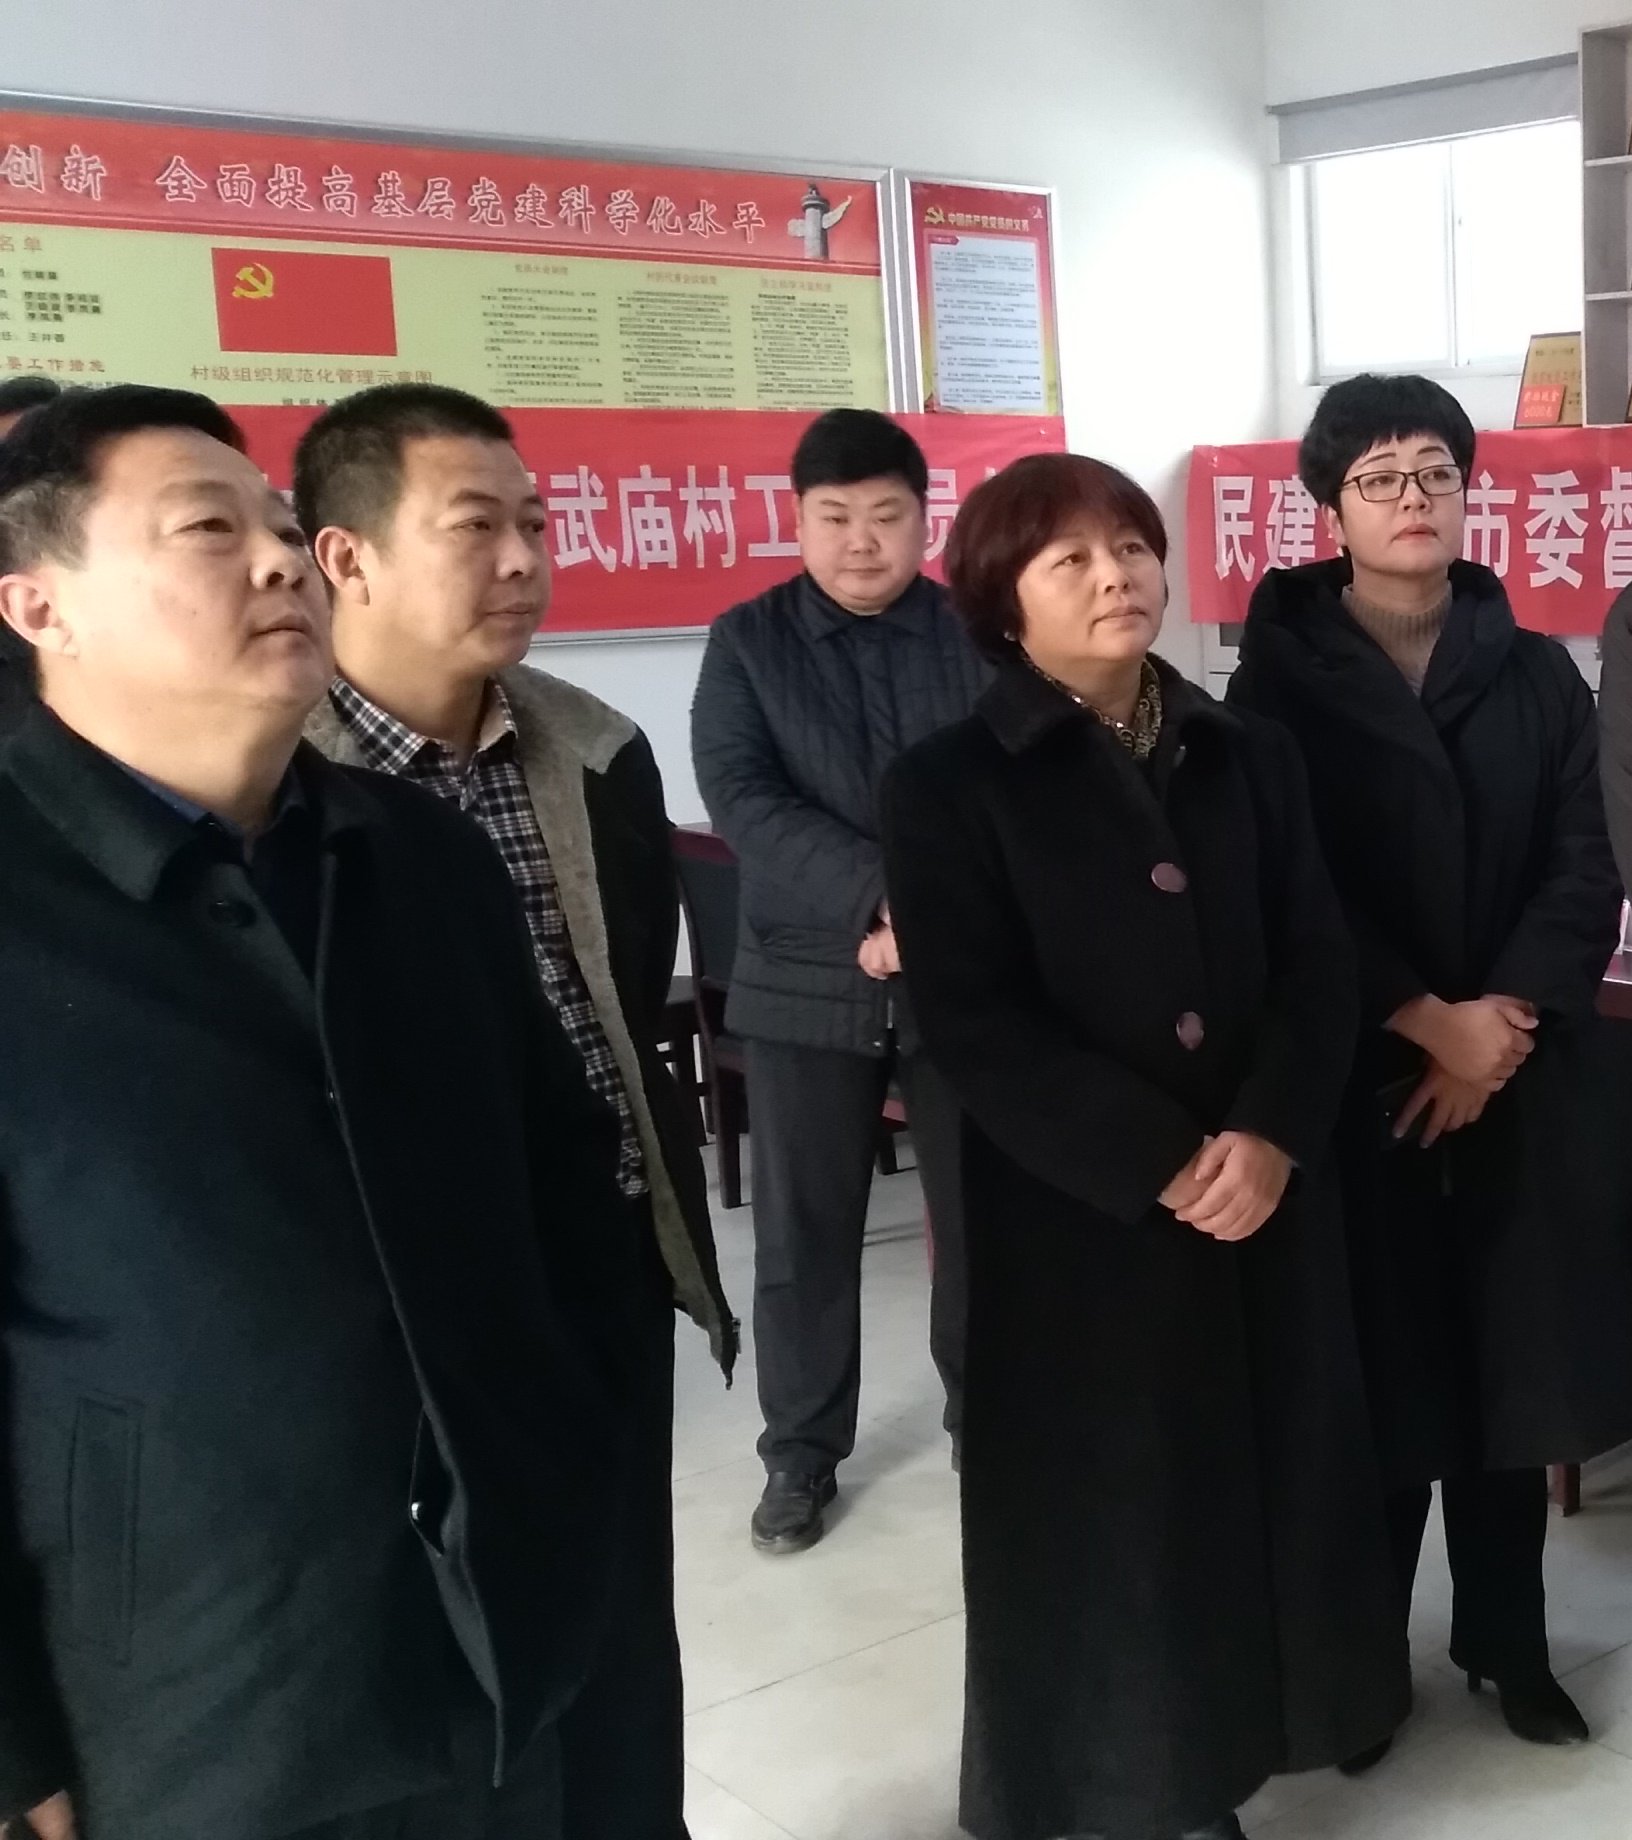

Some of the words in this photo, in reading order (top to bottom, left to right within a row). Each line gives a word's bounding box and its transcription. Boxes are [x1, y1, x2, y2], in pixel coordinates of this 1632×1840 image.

[0, 143, 107, 200] 创新
[155, 155, 766, 243] 全面提高基层党建科学化水平
[189, 364, 434, 385] 村级组织规范化管理示意图
